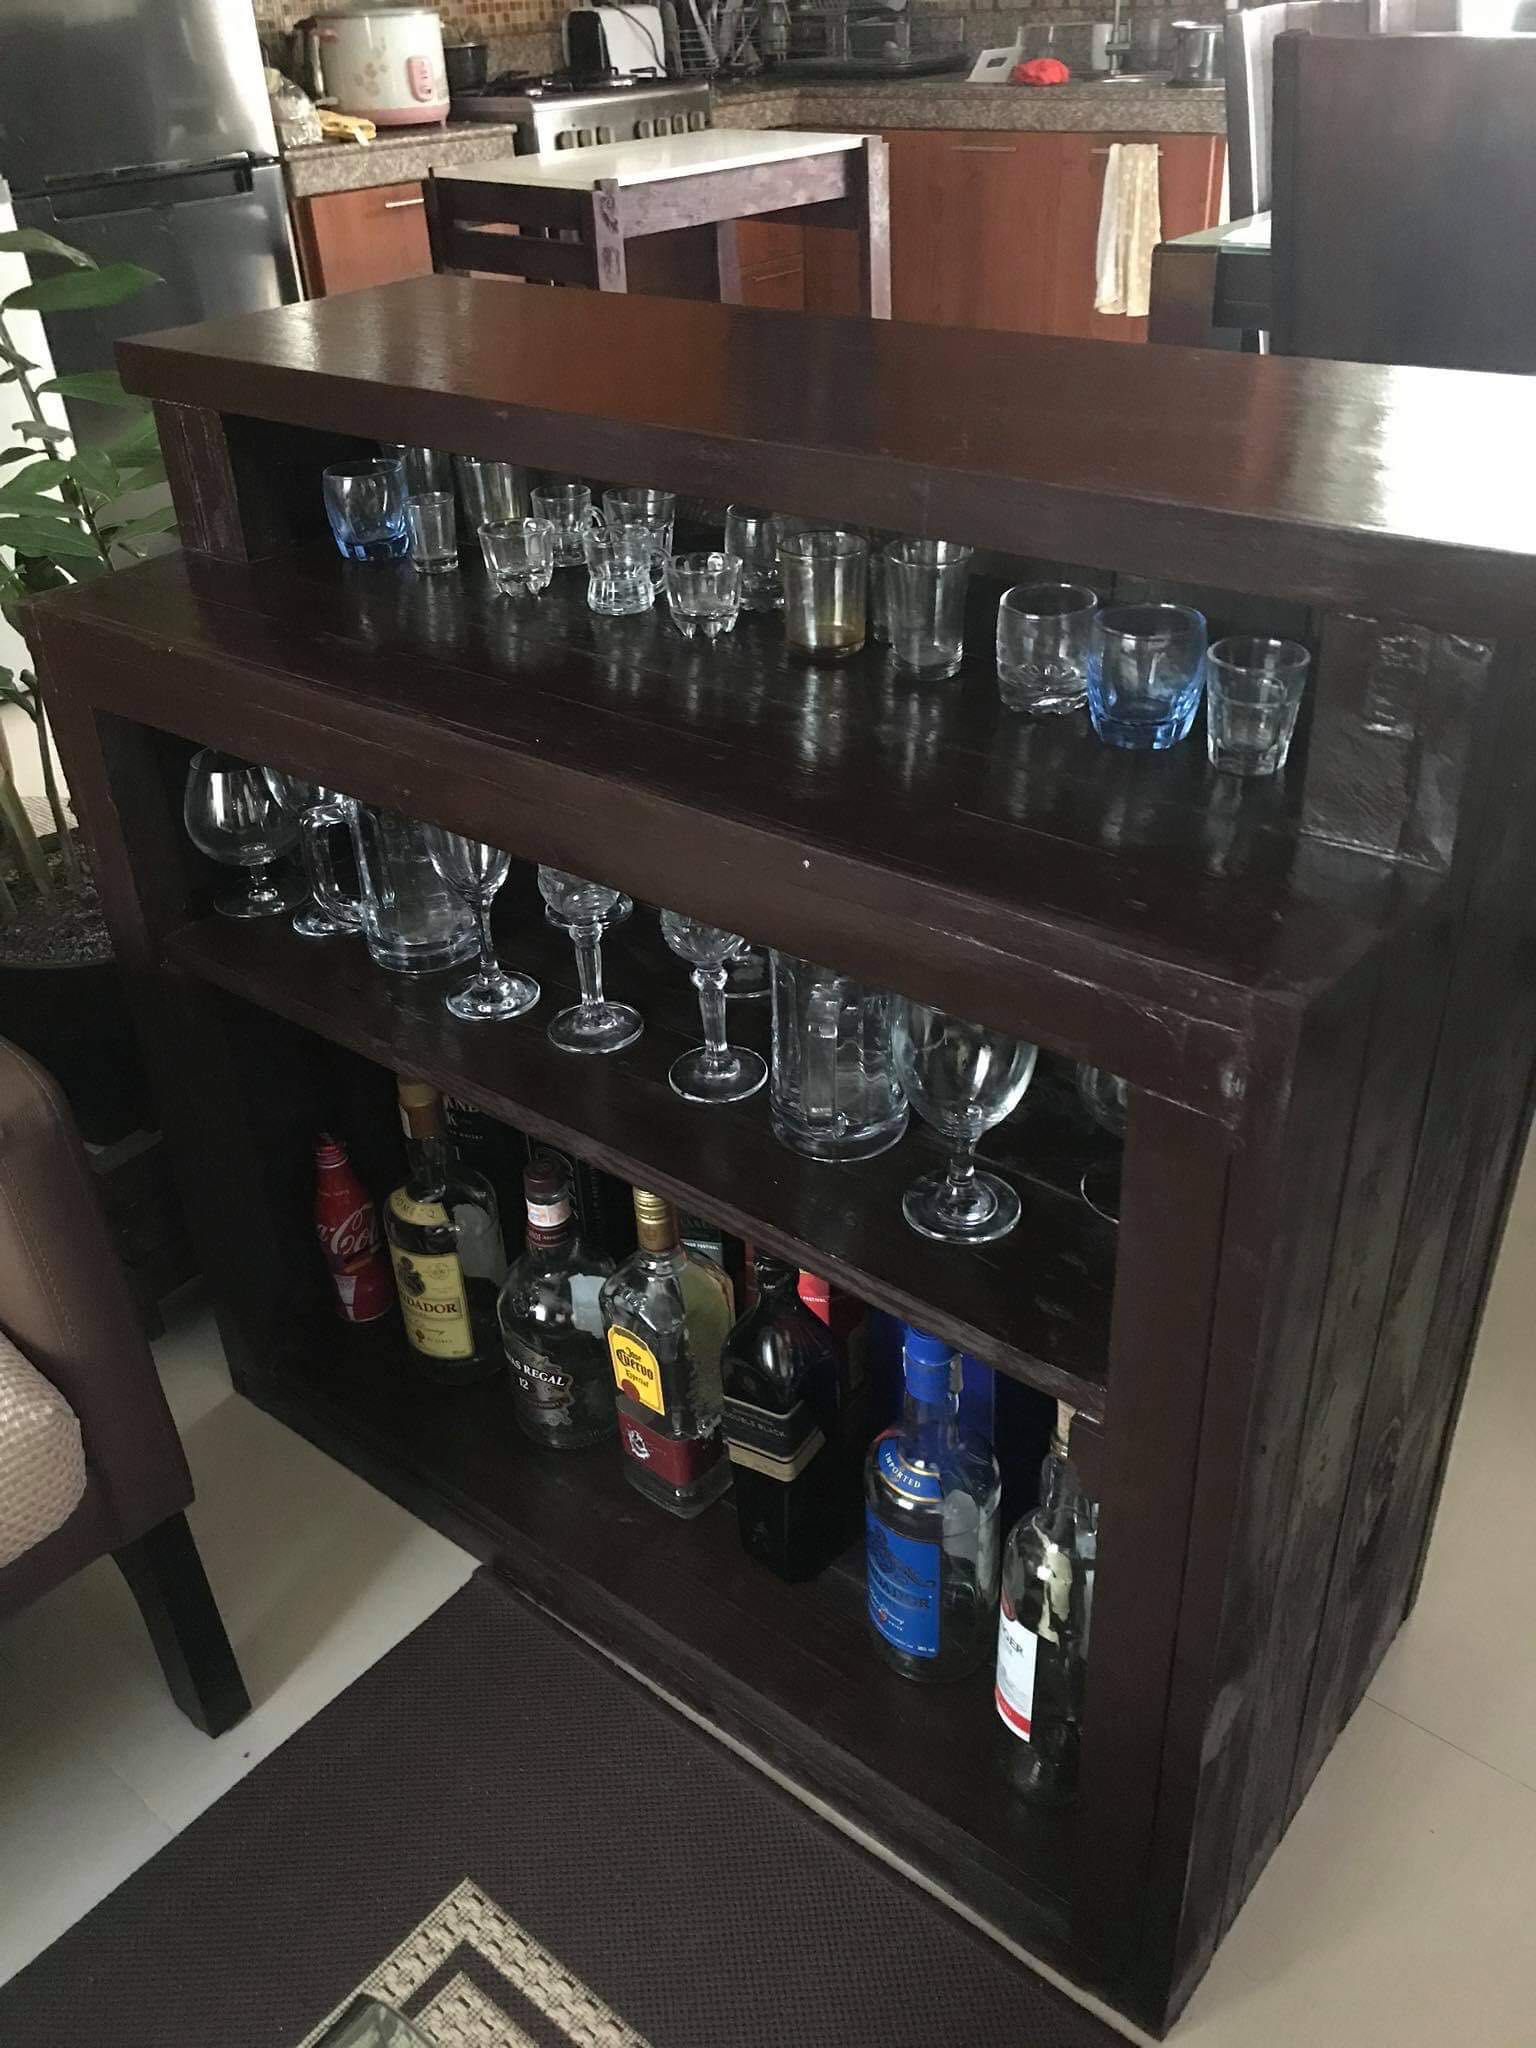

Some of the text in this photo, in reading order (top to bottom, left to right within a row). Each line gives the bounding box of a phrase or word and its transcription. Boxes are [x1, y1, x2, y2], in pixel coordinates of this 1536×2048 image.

[523, 1364, 566, 1387] REGAL
[615, 1349, 655, 1381] Cuervo
[519, 1377, 530, 1392] 12
[884, 1452, 922, 1489] IMPORTED
